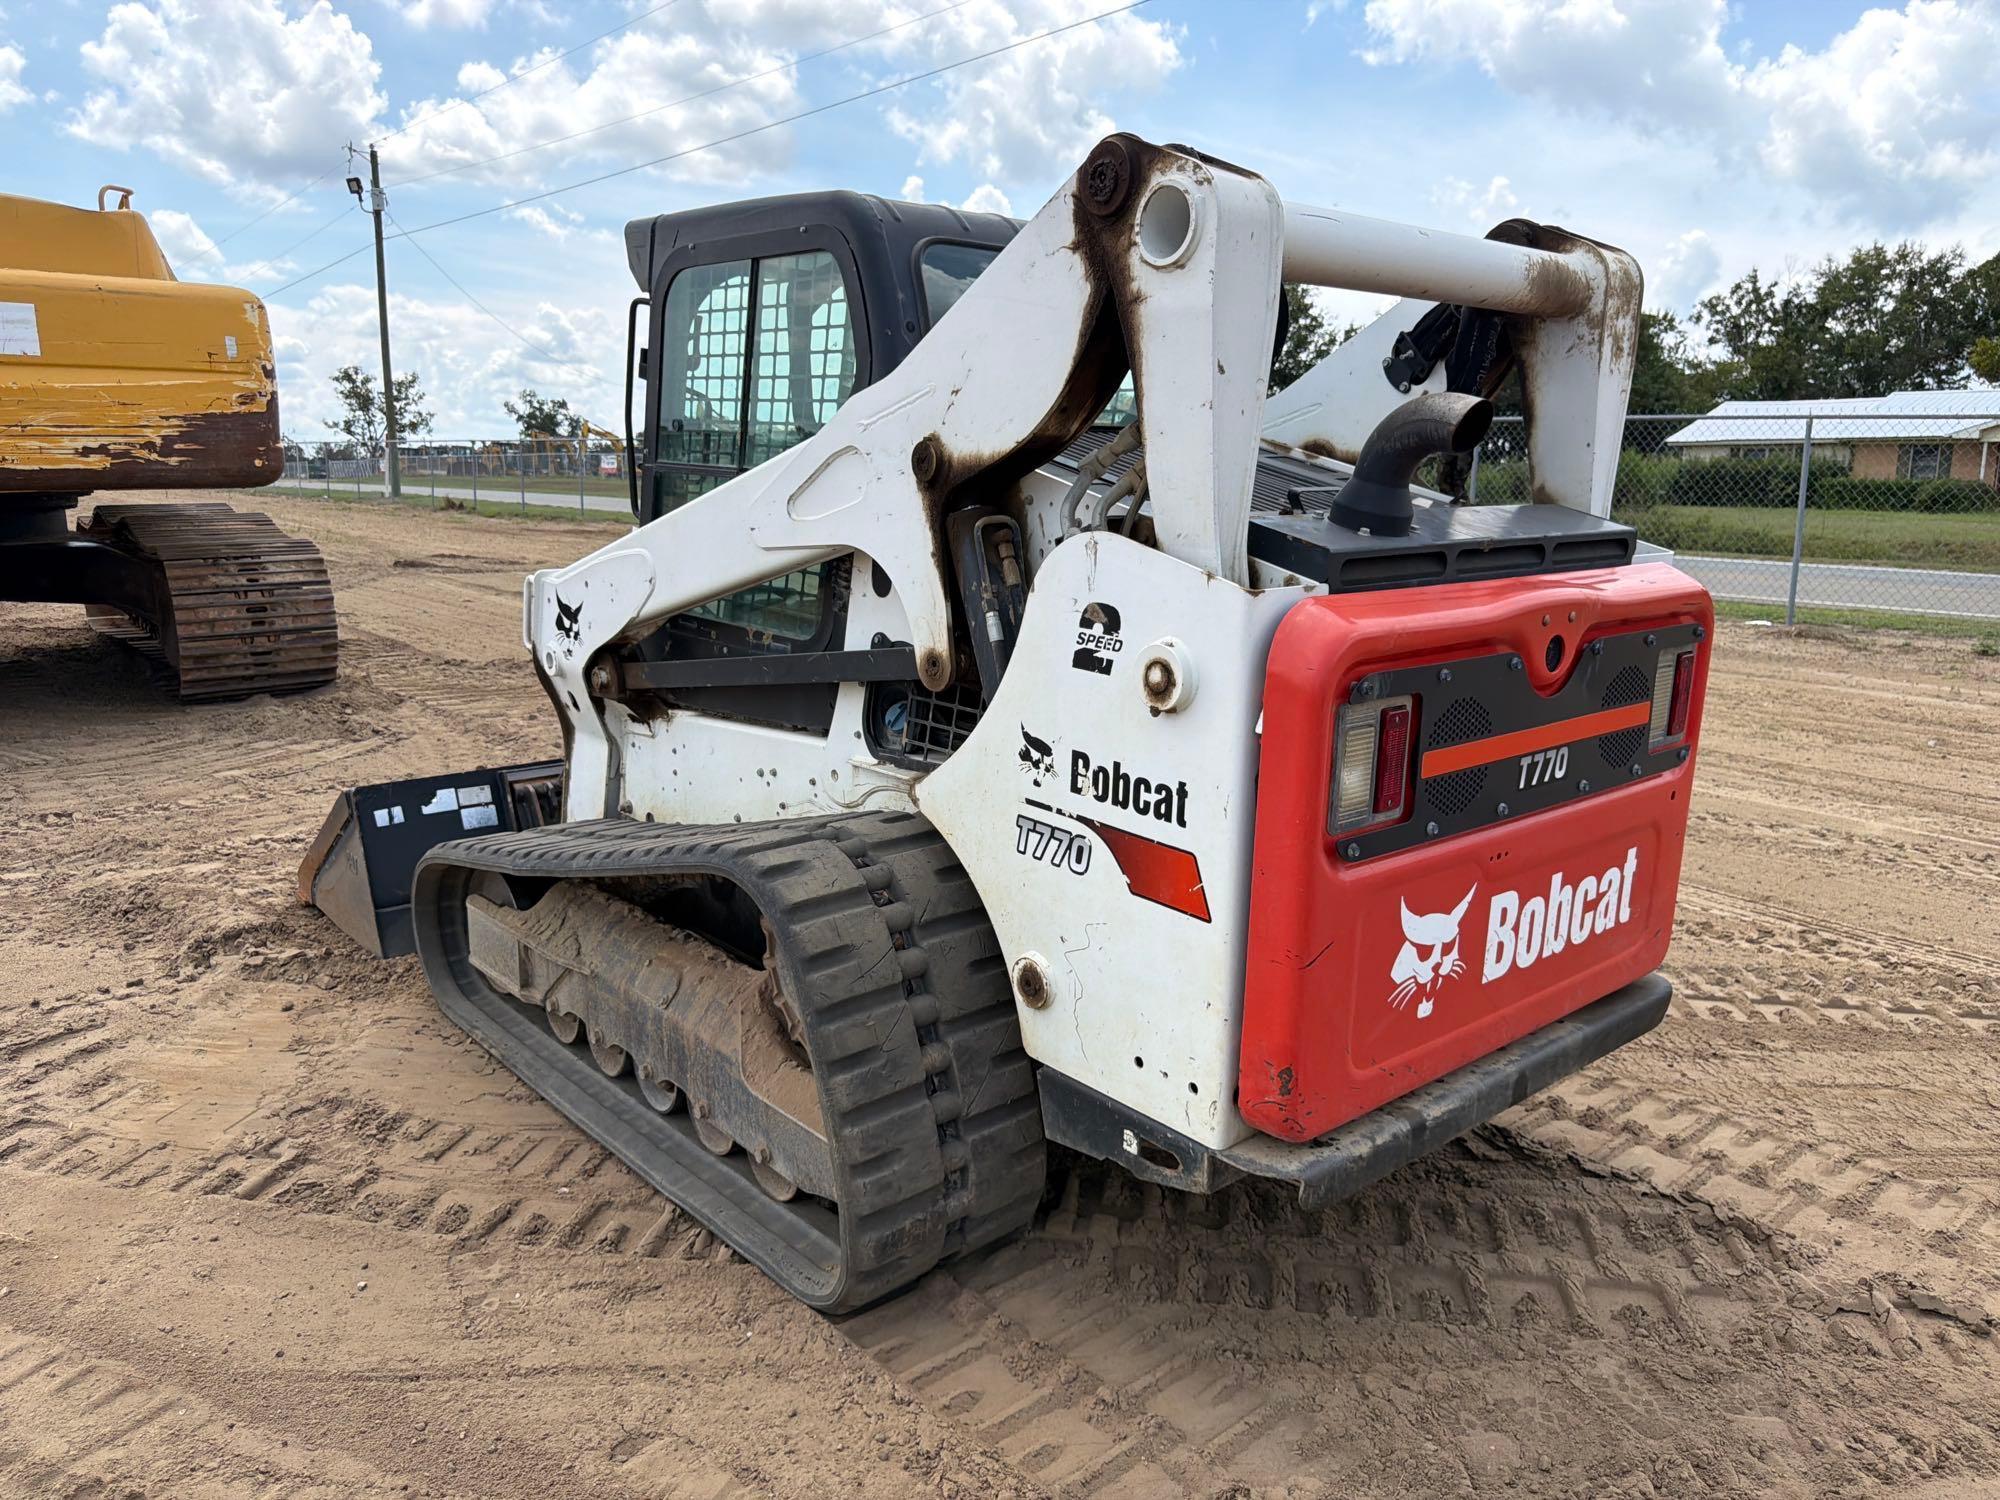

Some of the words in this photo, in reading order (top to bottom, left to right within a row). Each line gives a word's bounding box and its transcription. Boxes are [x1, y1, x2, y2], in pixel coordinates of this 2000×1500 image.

[1076, 632, 1123, 652] SPEED
[1070, 749, 1188, 828] Bobcat
[1519, 746, 1569, 790] T770
[1016, 814, 1092, 875] T770
[1481, 846, 1637, 984] Bobcat
